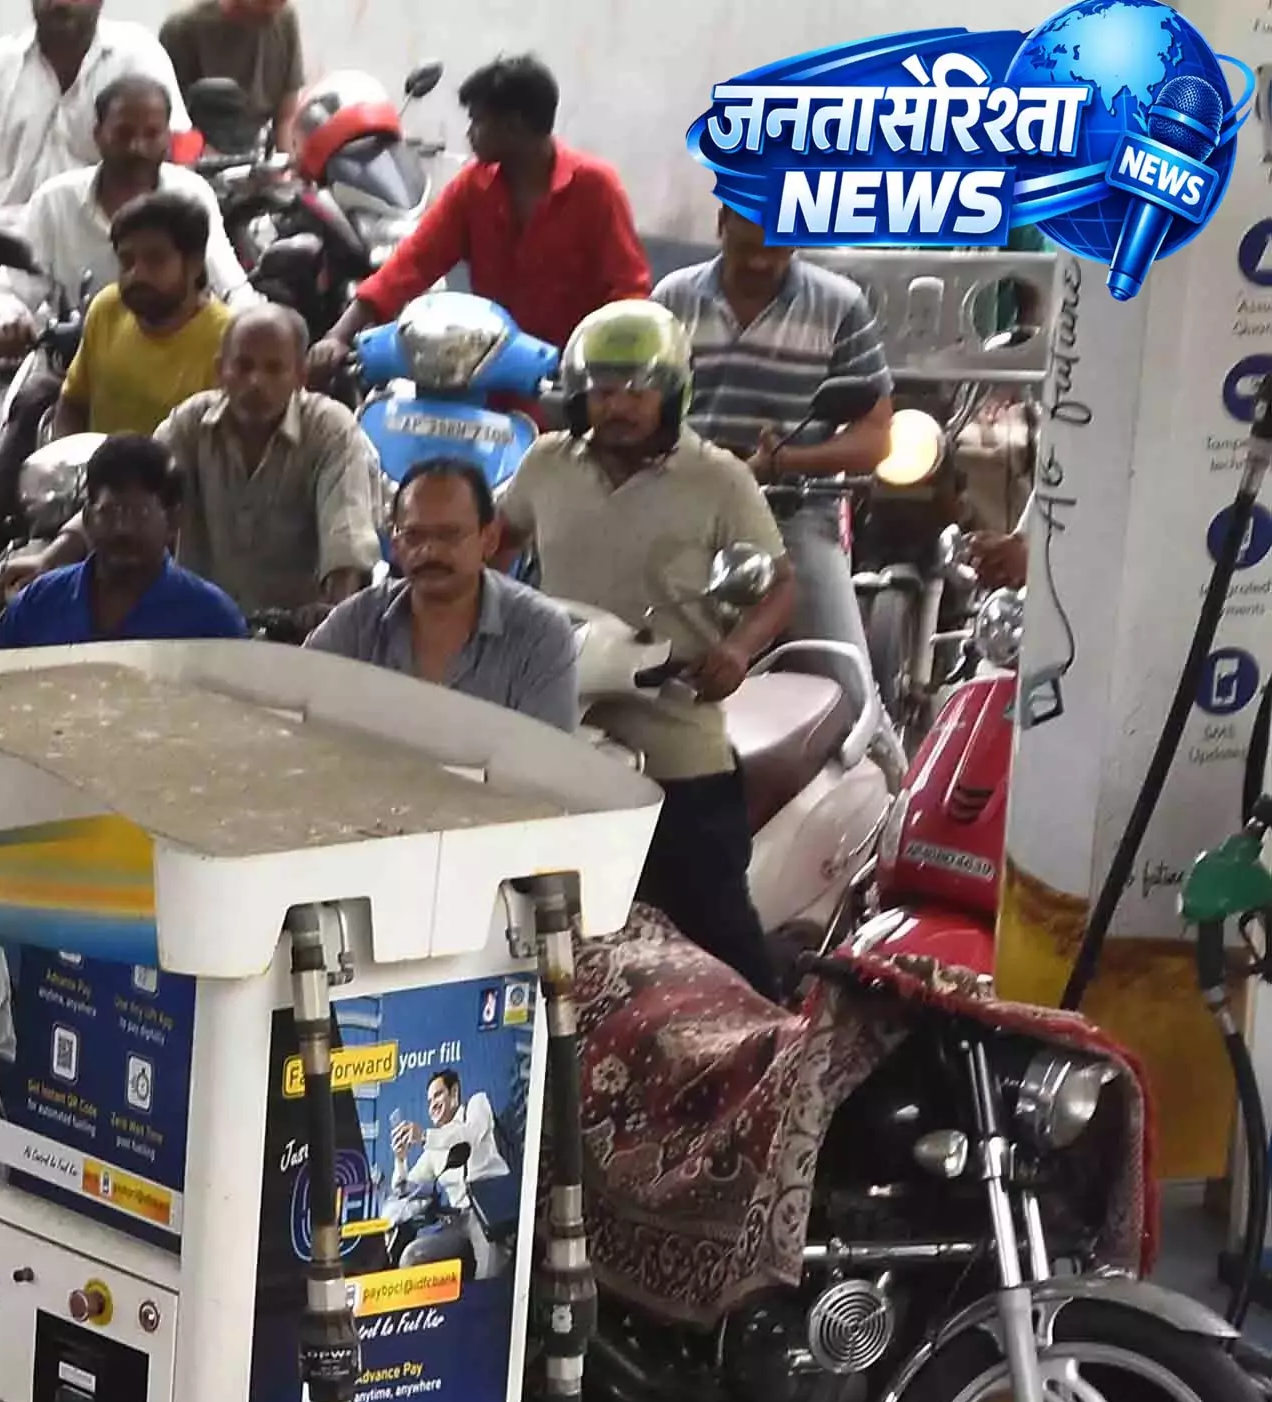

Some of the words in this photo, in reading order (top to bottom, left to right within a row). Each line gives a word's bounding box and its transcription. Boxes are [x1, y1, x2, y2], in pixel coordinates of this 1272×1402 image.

[331, 1051, 394, 1080] orward
[399, 1047, 433, 1074] your
[440, 1040, 461, 1063] fill
[402, 1360, 424, 1380] Pay
[395, 1377, 442, 1399] anywhere
